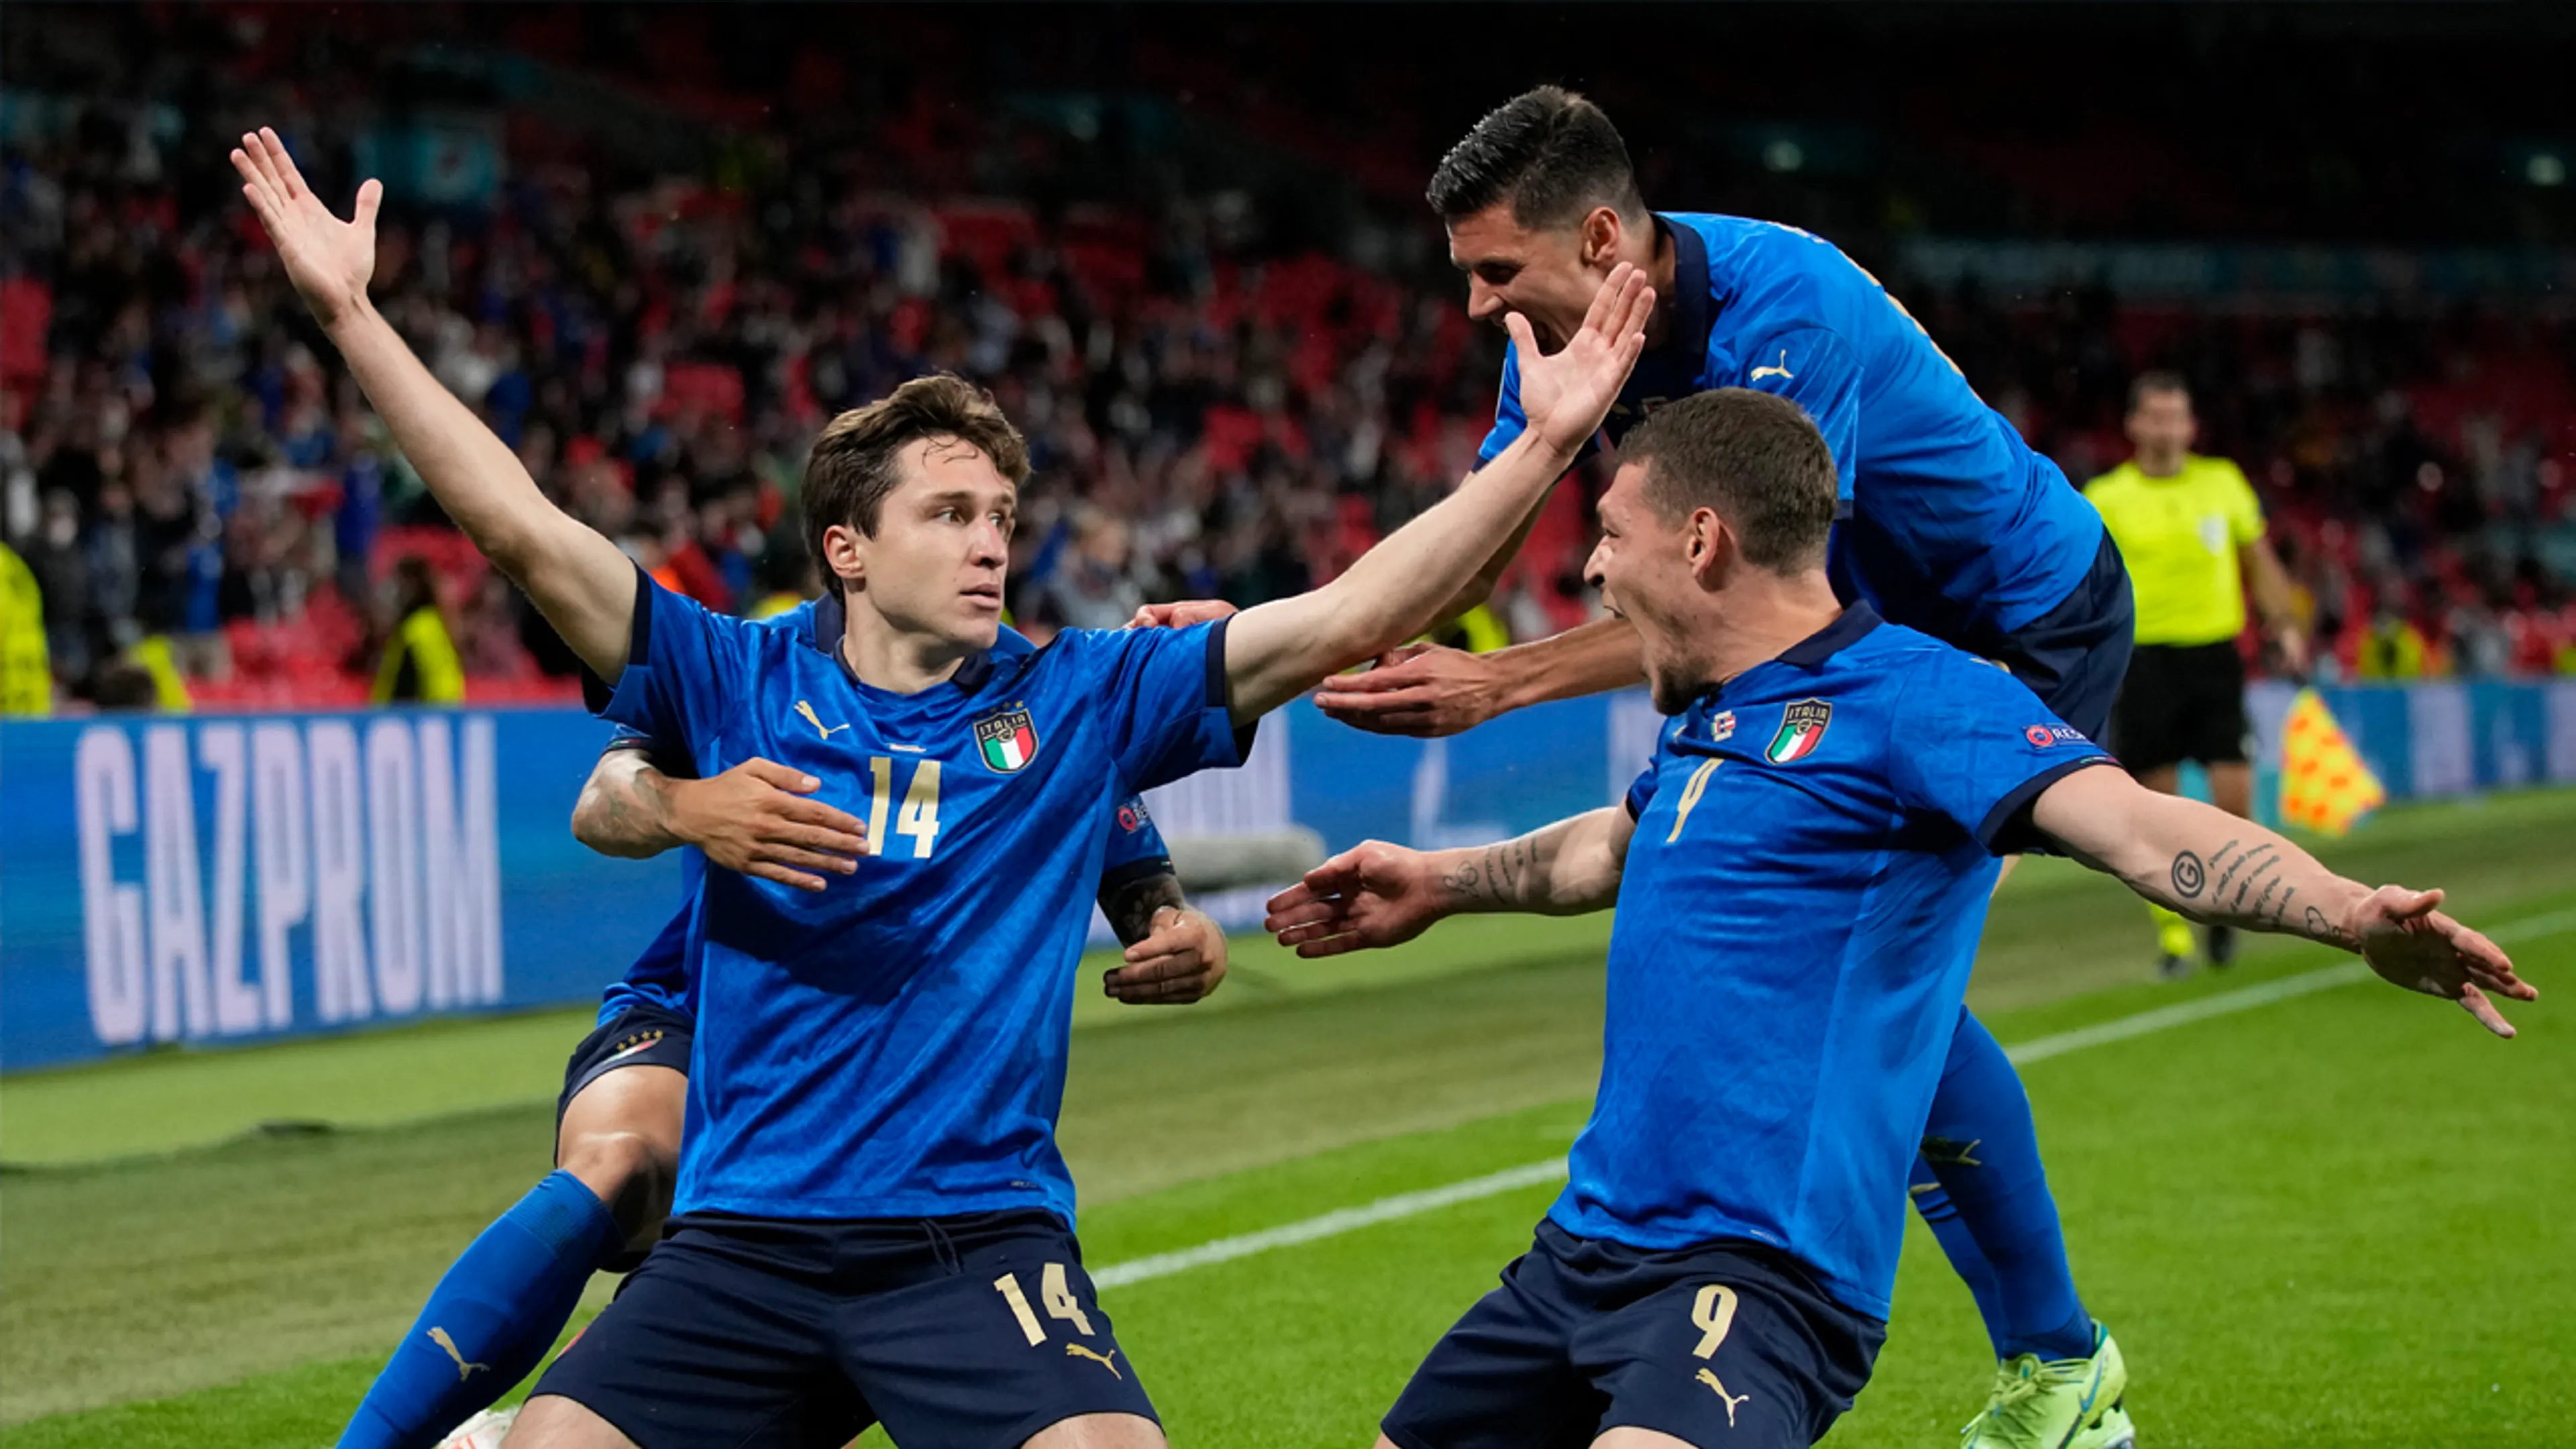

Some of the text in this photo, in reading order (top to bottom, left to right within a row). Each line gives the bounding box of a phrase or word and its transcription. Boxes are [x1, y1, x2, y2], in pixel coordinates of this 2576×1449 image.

[979, 714, 1026, 737] ITALIA
[1788, 706, 1829, 720] ITALIA
[868, 756, 941, 859] 14
[1666, 757, 1725, 843] 9
[75, 714, 504, 1044] GAZPROM
[994, 1263, 1095, 1348] 14
[1690, 1283, 1738, 1360] 9
